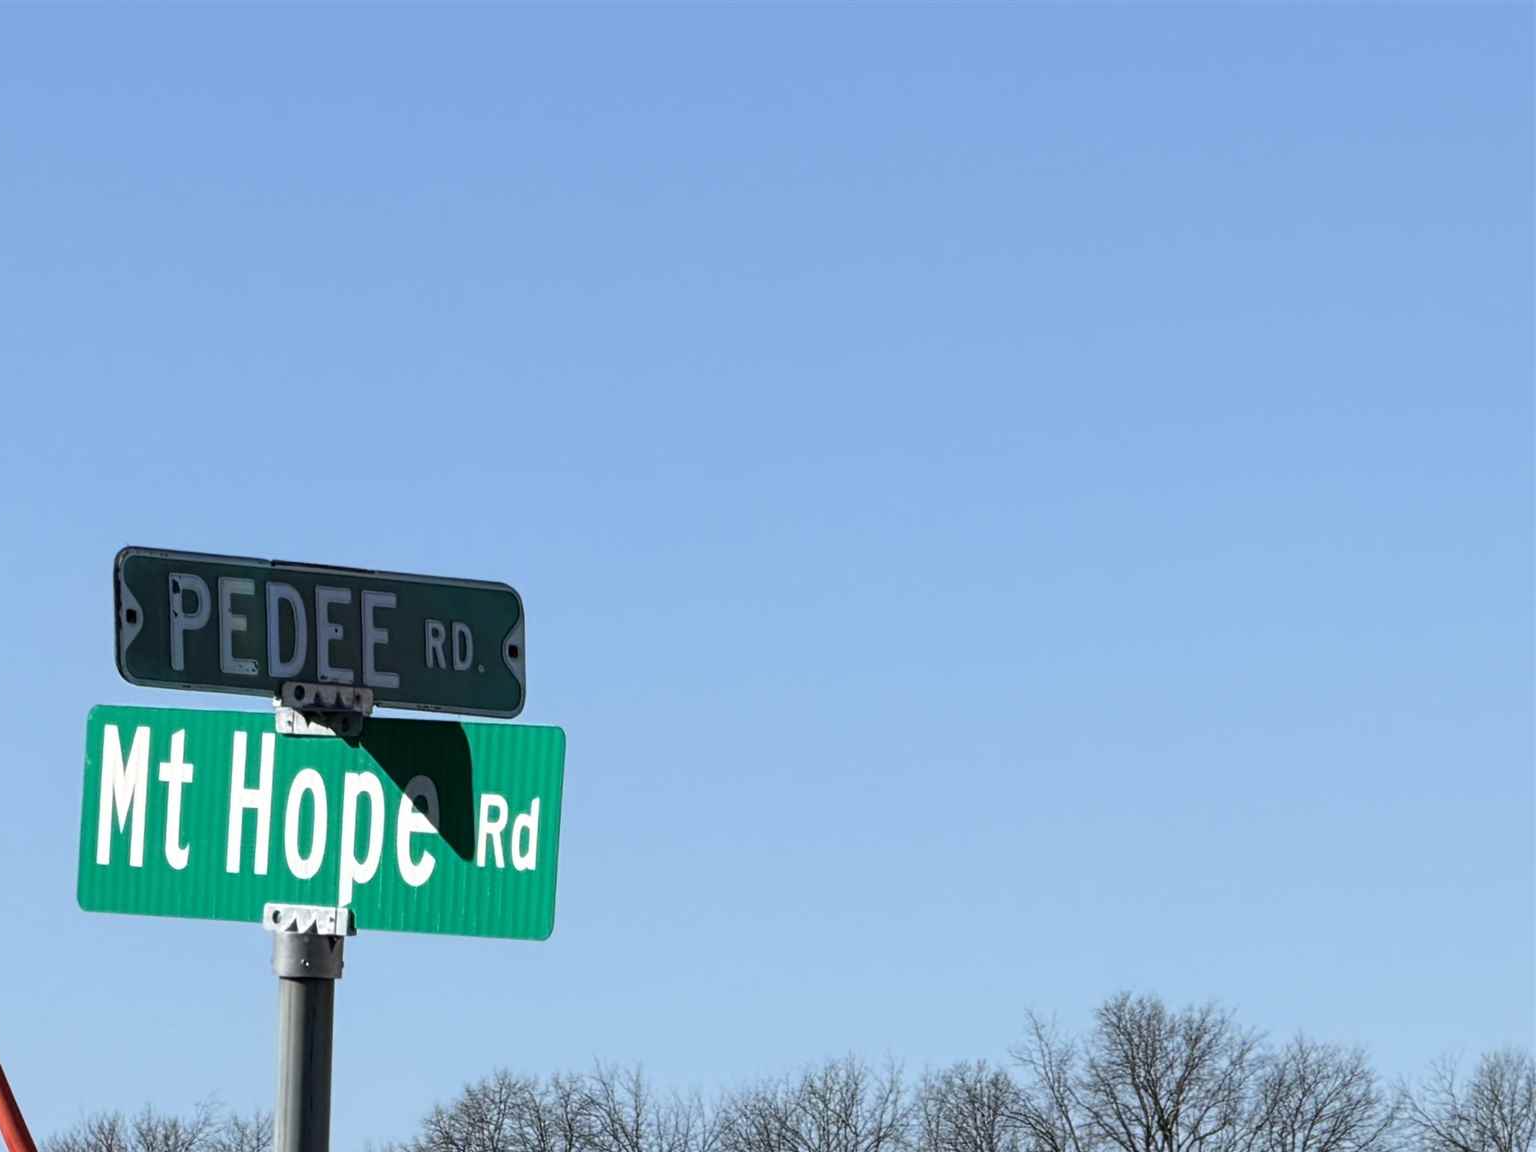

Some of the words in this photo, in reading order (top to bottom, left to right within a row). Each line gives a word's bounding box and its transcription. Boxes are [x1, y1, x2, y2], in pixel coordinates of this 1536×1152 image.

[168, 572, 401, 689] PEDEE
[425, 619, 486, 673] RD.
[96, 724, 194, 870] Mt
[226, 731, 440, 907] Hope
[476, 793, 541, 871] Rd
